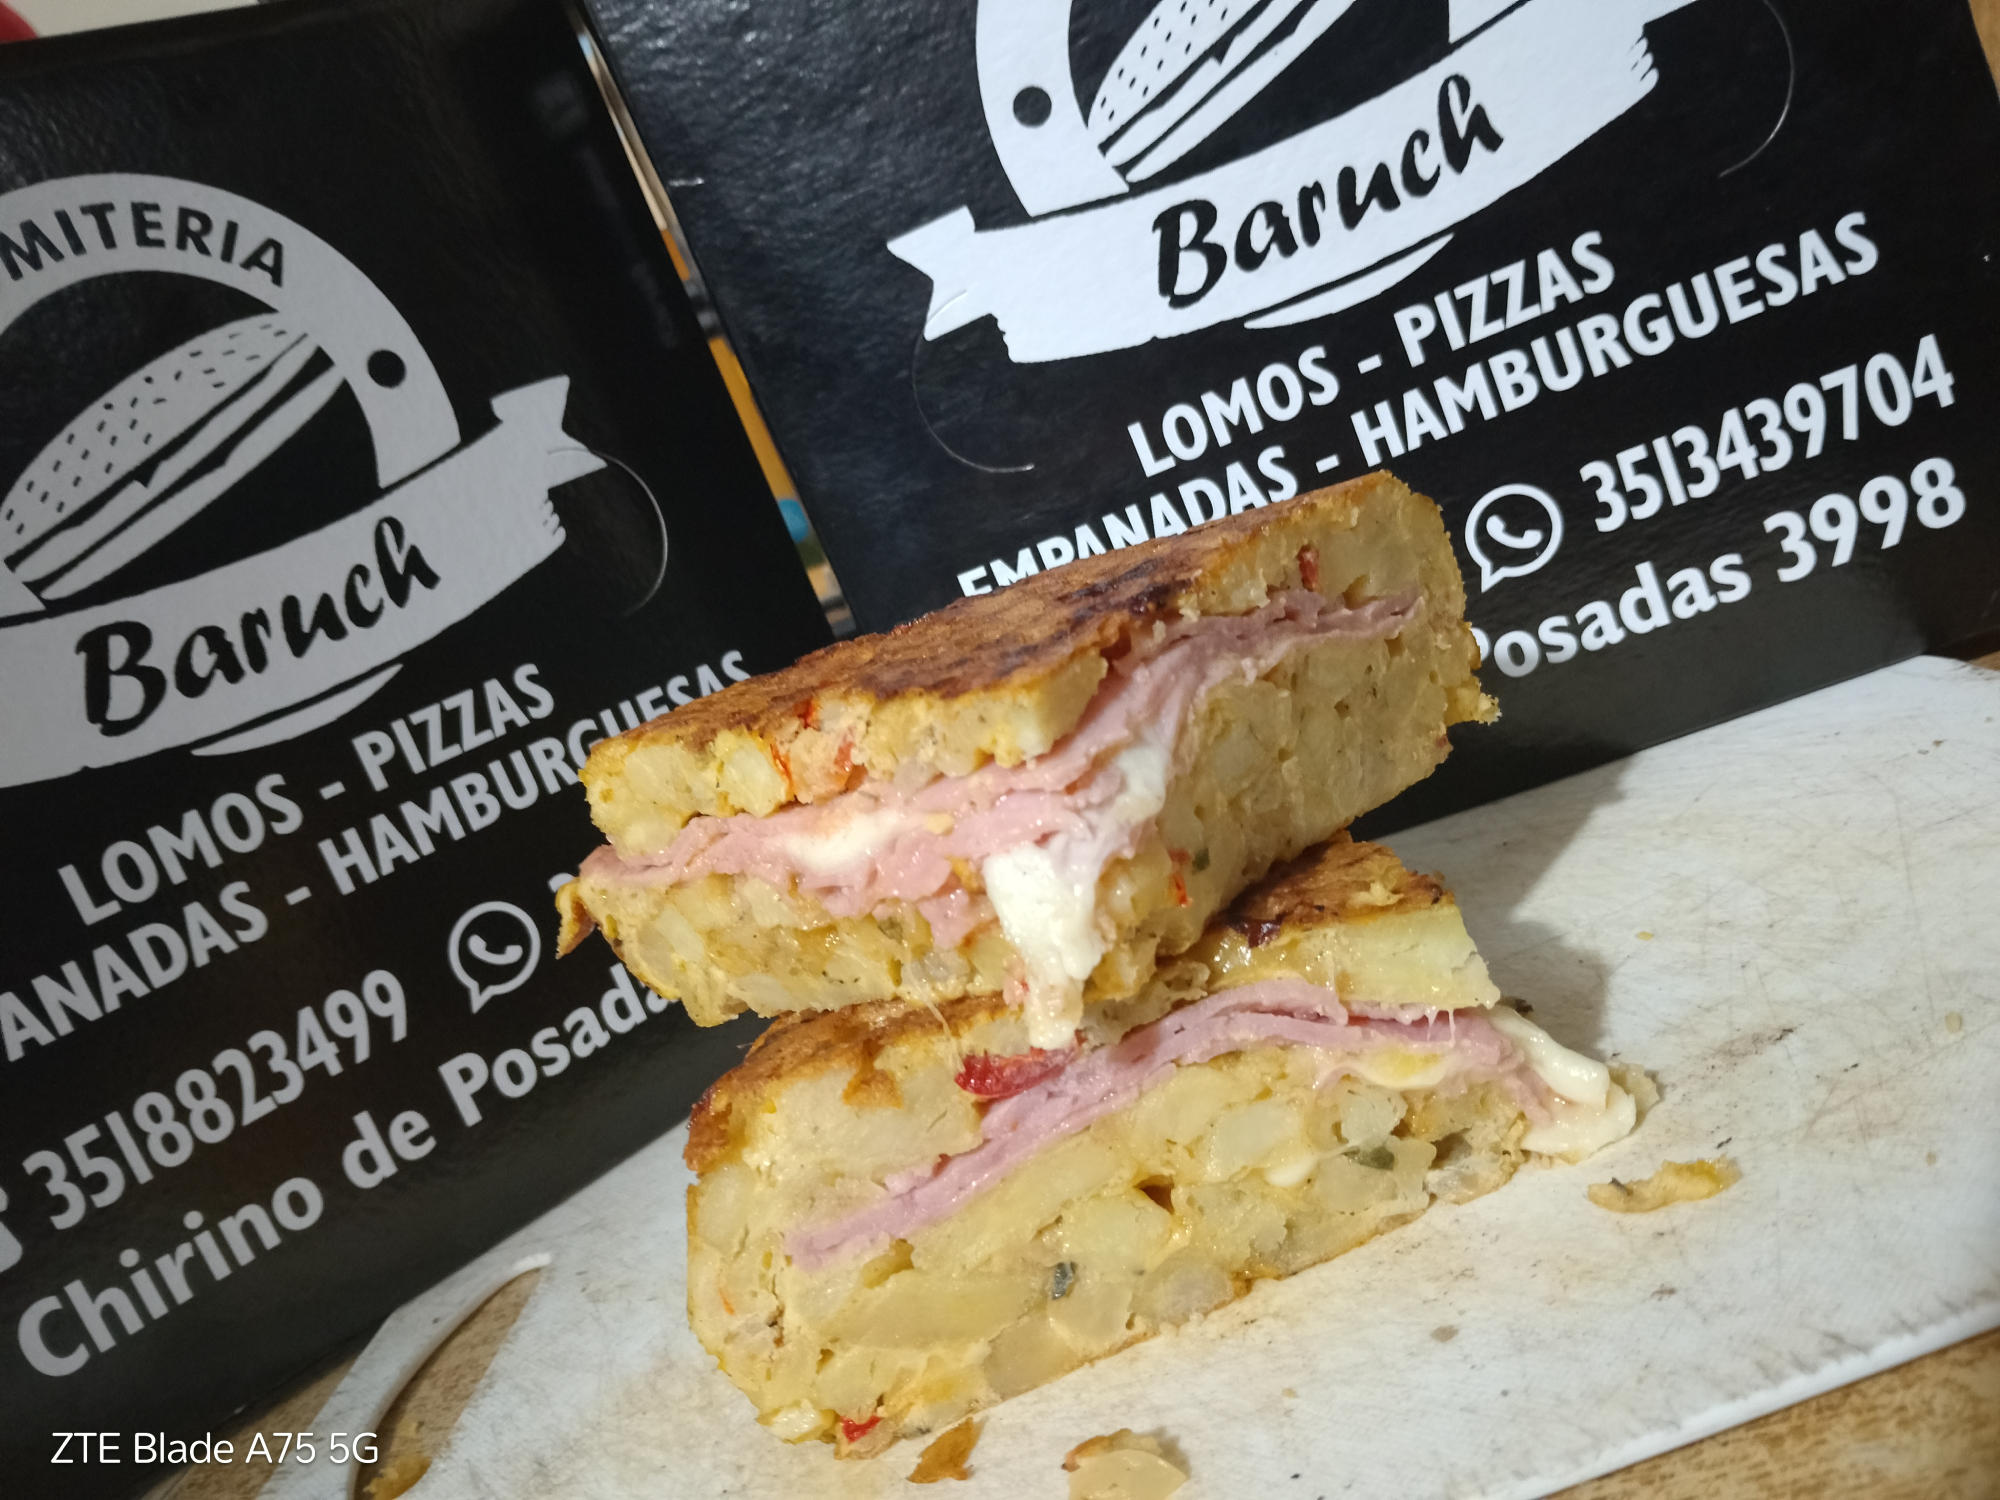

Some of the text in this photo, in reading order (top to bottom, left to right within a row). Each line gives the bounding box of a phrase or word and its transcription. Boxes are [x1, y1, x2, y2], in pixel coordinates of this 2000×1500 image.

[1152, 74, 1504, 309] Baruch
[1127, 346, 1340, 478] LOMOS
[1393, 231, 1616, 368] PIZZAS
[1350, 211, 1879, 468] HAMBURGUESAS
[1579, 333, 1956, 533] 3513439704
[75, 516, 441, 737] Baruch
[1469, 457, 1967, 678] osadas 3998
[57, 773, 304, 926] LOMOS
[351, 663, 555, 792] PIZZAS
[22, 969, 408, 1231] 3518823499
[17, 1177, 324, 1377] Chirino
[342, 1110, 437, 1189] de
